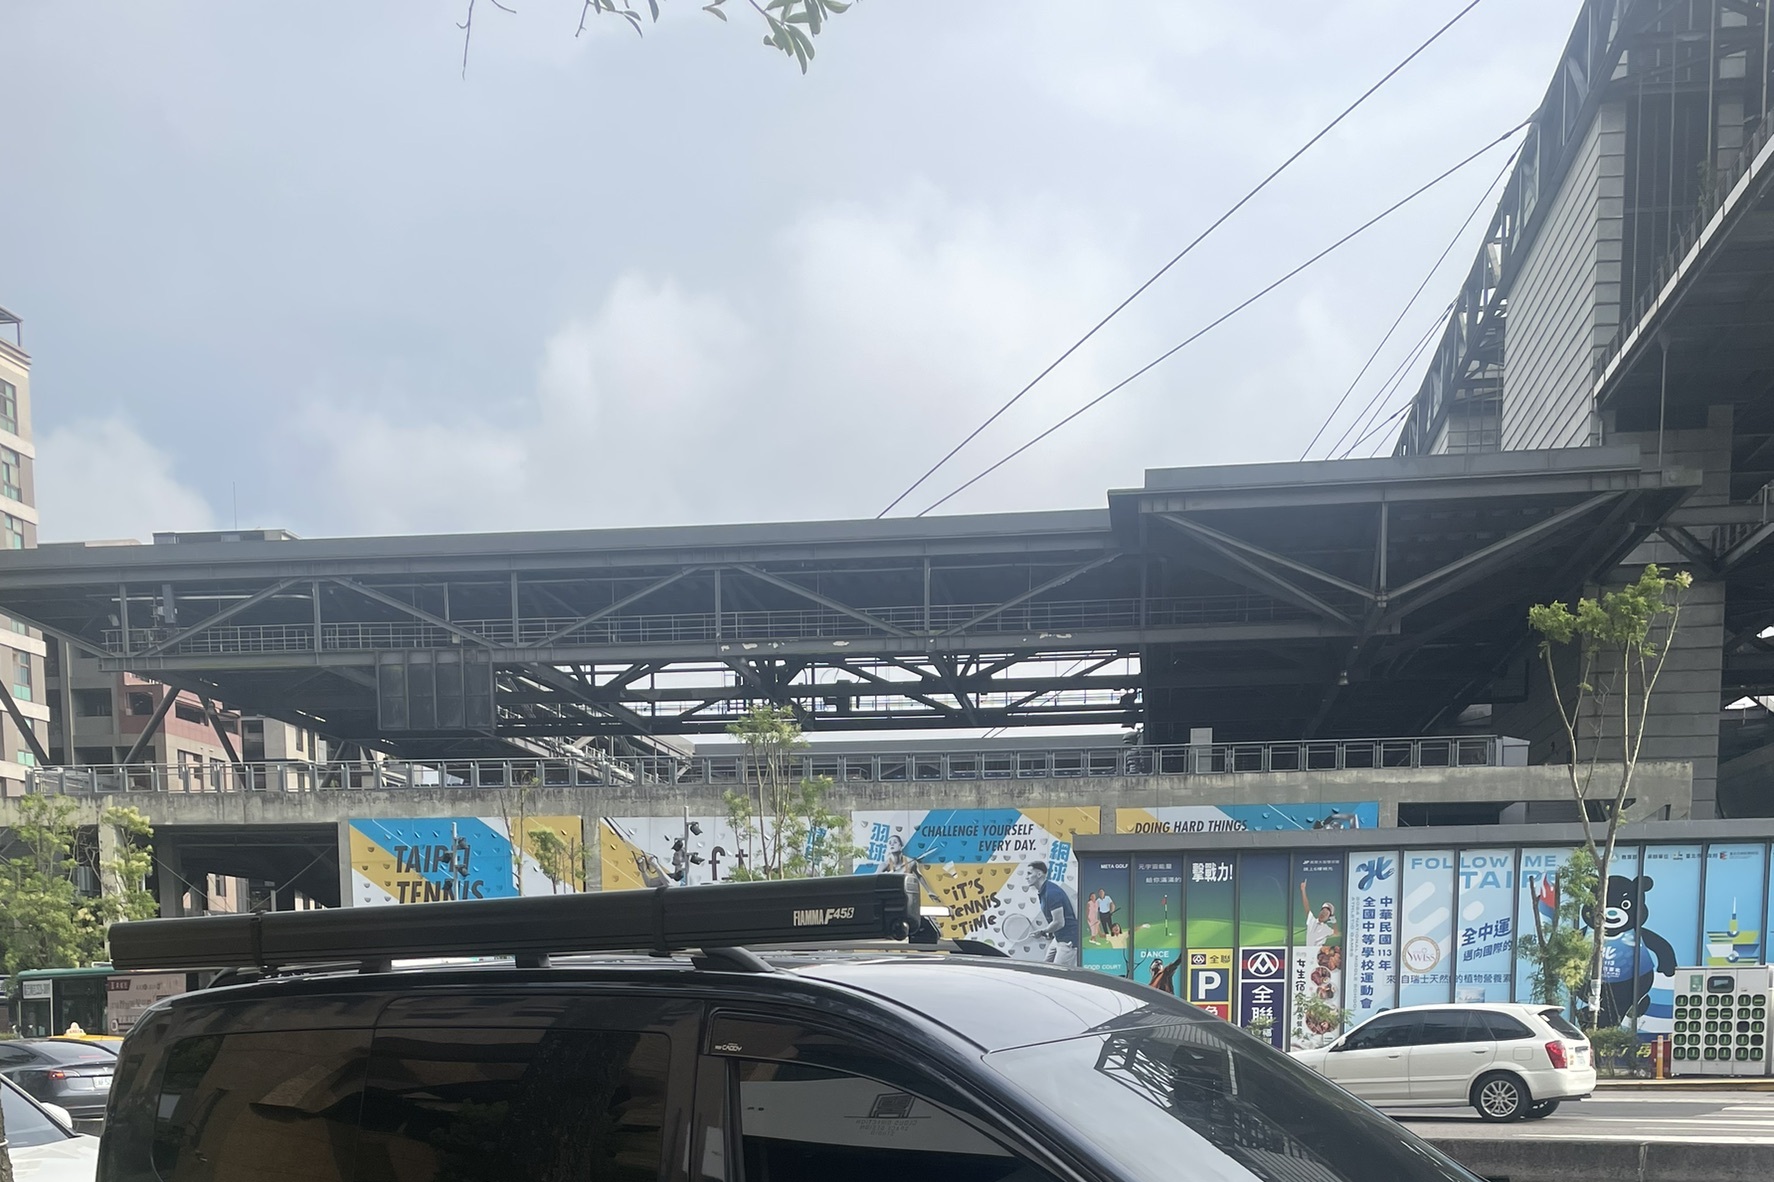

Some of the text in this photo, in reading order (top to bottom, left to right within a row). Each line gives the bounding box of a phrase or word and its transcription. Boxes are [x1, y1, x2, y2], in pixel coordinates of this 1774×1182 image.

[921, 824, 1034, 837] CHALLENGE YOURSELF
[1134, 819, 1248, 834] DOING HARD THINGS
[979, 839, 1037, 852] EVERY DAY.
[394, 845, 471, 874] TAIPI
[1411, 855, 1557, 870] FOLLOW ME
[1460, 870, 1556, 889] TAIP
[793, 909, 824, 926] FIAMMA
[1461, 917, 1513, 947] 全中運
[1140, 950, 1170, 958] DANCE
[1198, 971, 1222, 999] P
